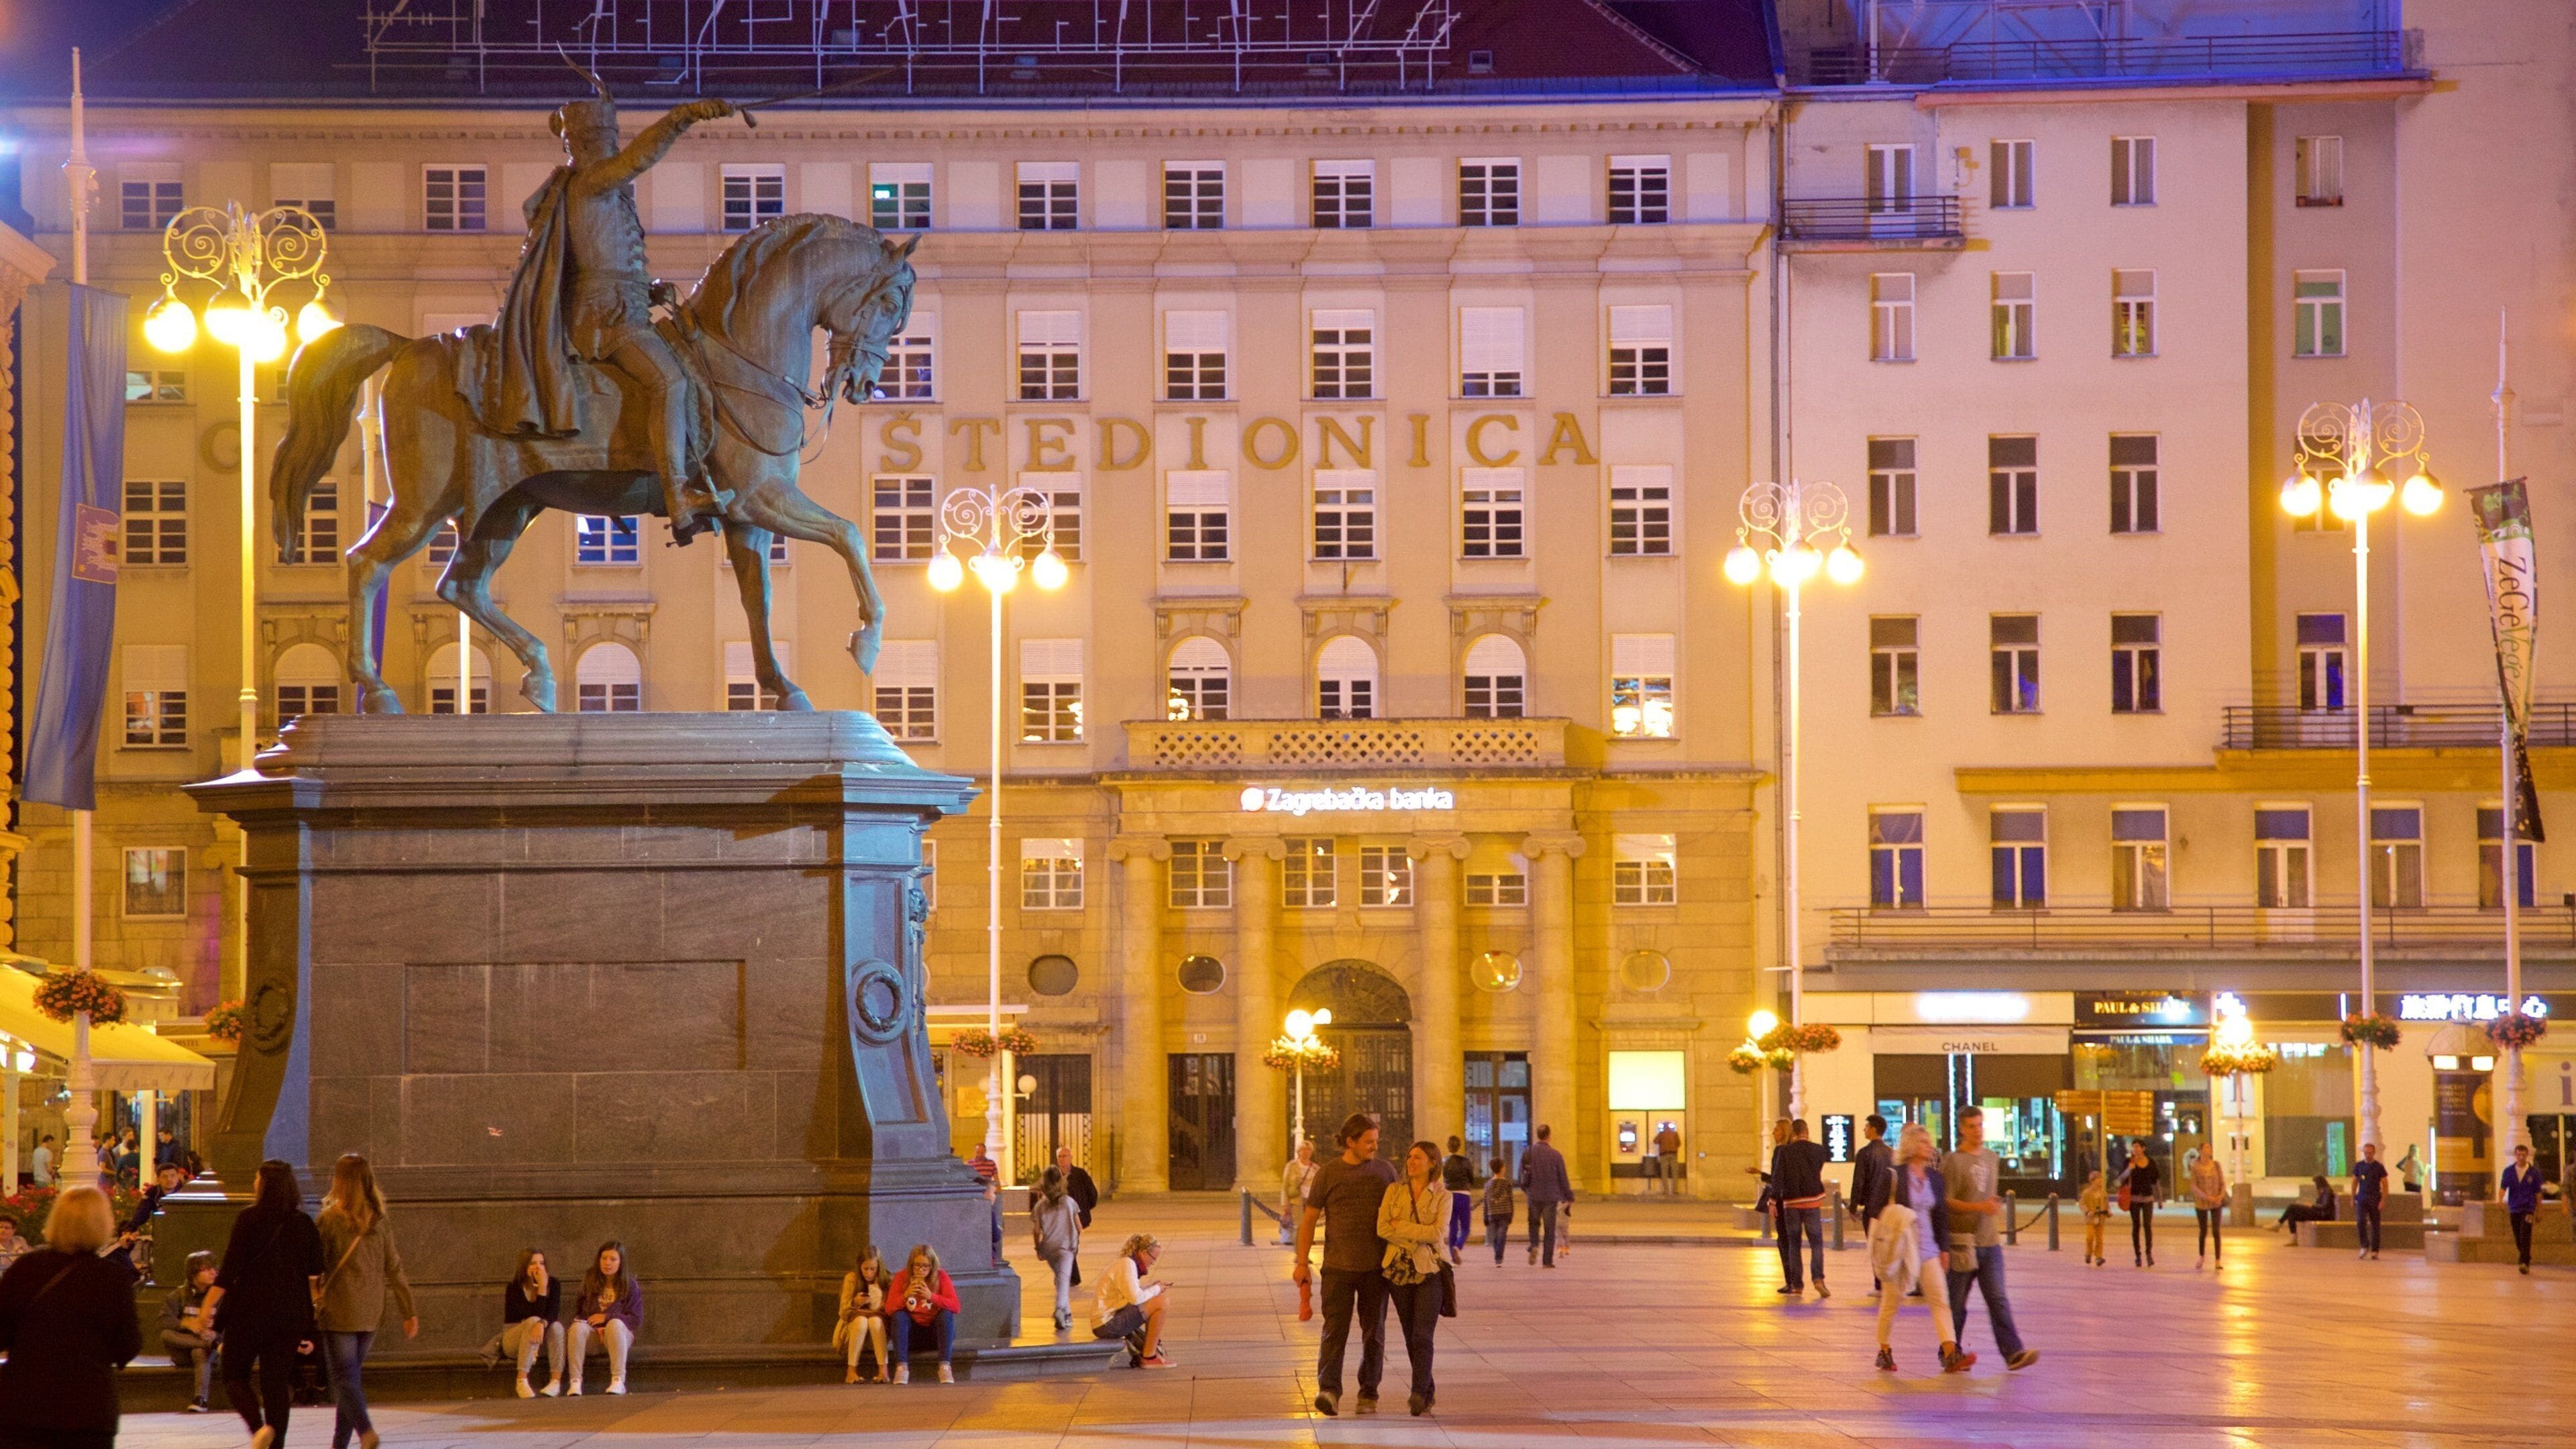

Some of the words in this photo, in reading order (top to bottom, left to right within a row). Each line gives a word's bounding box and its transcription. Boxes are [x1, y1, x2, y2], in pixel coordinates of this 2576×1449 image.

[879, 411, 1599, 472] ŠTEDIONICA
[1267, 788, 1385, 816] Zagrebačka
[1390, 787, 1453, 809] banka
[2094, 1002, 2128, 1014] PAUL
[2129, 1002, 2140, 1014] &
[2141, 1002, 2191, 1014] SHAK
[1942, 1042, 1998, 1051] CHANEL
